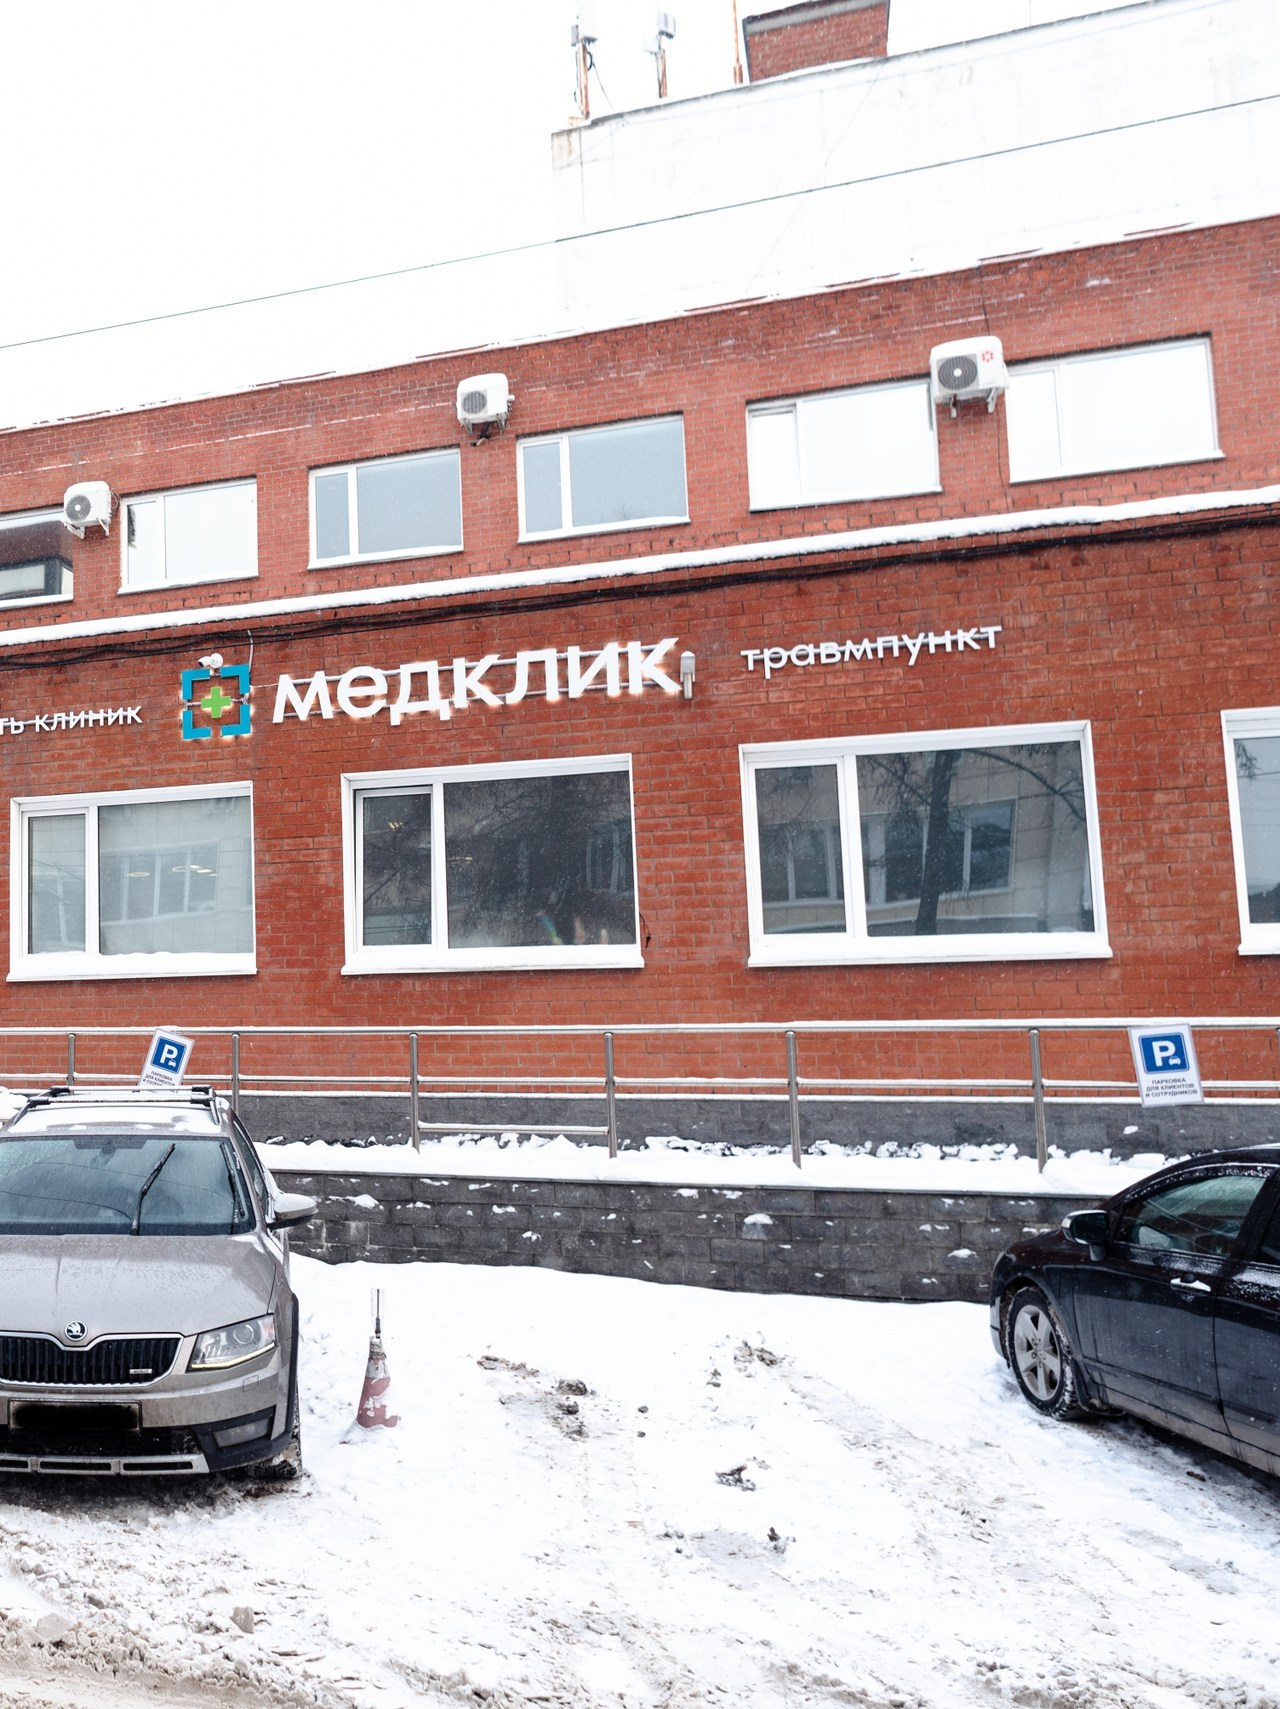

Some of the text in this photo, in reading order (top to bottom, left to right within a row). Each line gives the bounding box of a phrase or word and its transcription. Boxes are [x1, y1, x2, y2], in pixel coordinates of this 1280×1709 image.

[740, 625, 1003, 680] травмпункт
[272, 637, 683, 726] медклик
[34, 704, 143, 732] клиник
[160, 1044, 178, 1064] P
[1152, 1040, 1176, 1067] P
